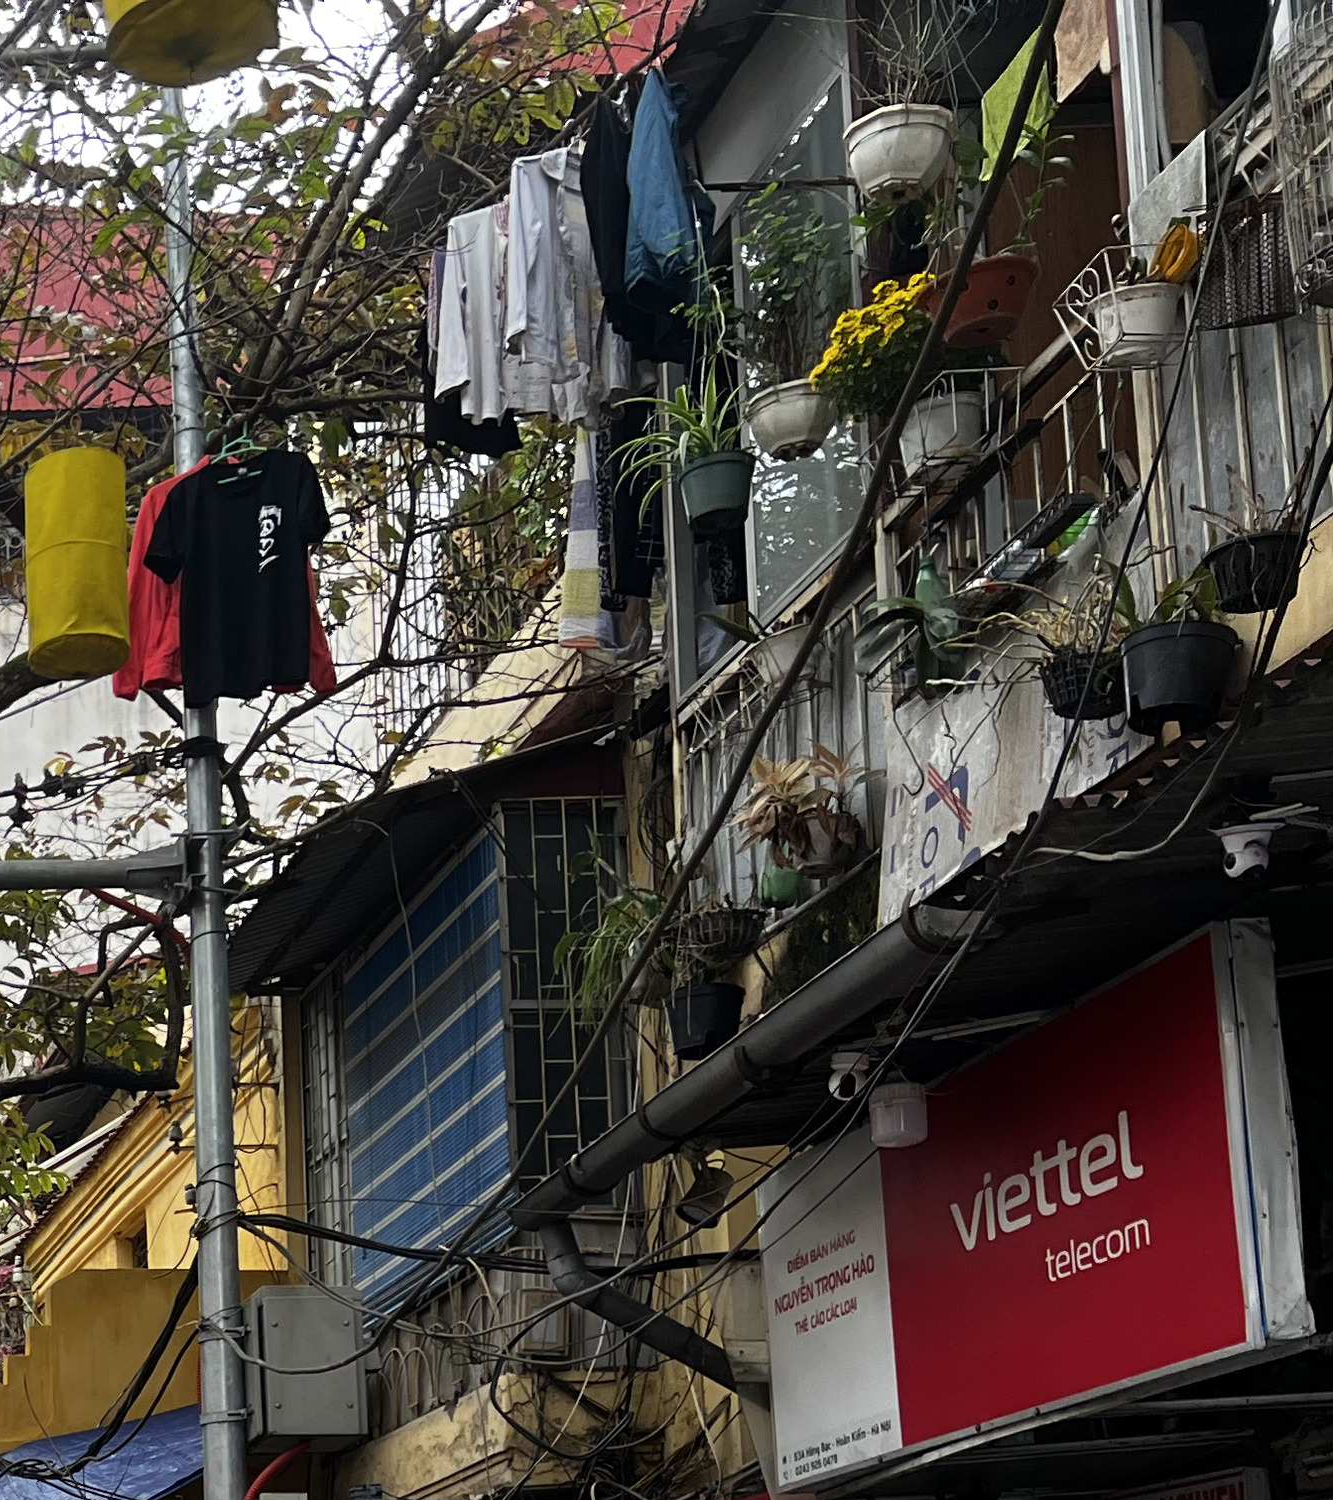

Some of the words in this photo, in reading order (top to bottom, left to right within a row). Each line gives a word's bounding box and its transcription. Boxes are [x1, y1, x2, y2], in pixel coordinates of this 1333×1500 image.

[950, 1110, 1144, 1250] viettel
[1045, 1219, 1150, 1282] telecom
[774, 1276, 814, 1316] NGUYỄN
[815, 1265, 851, 1297] TRỌNG
